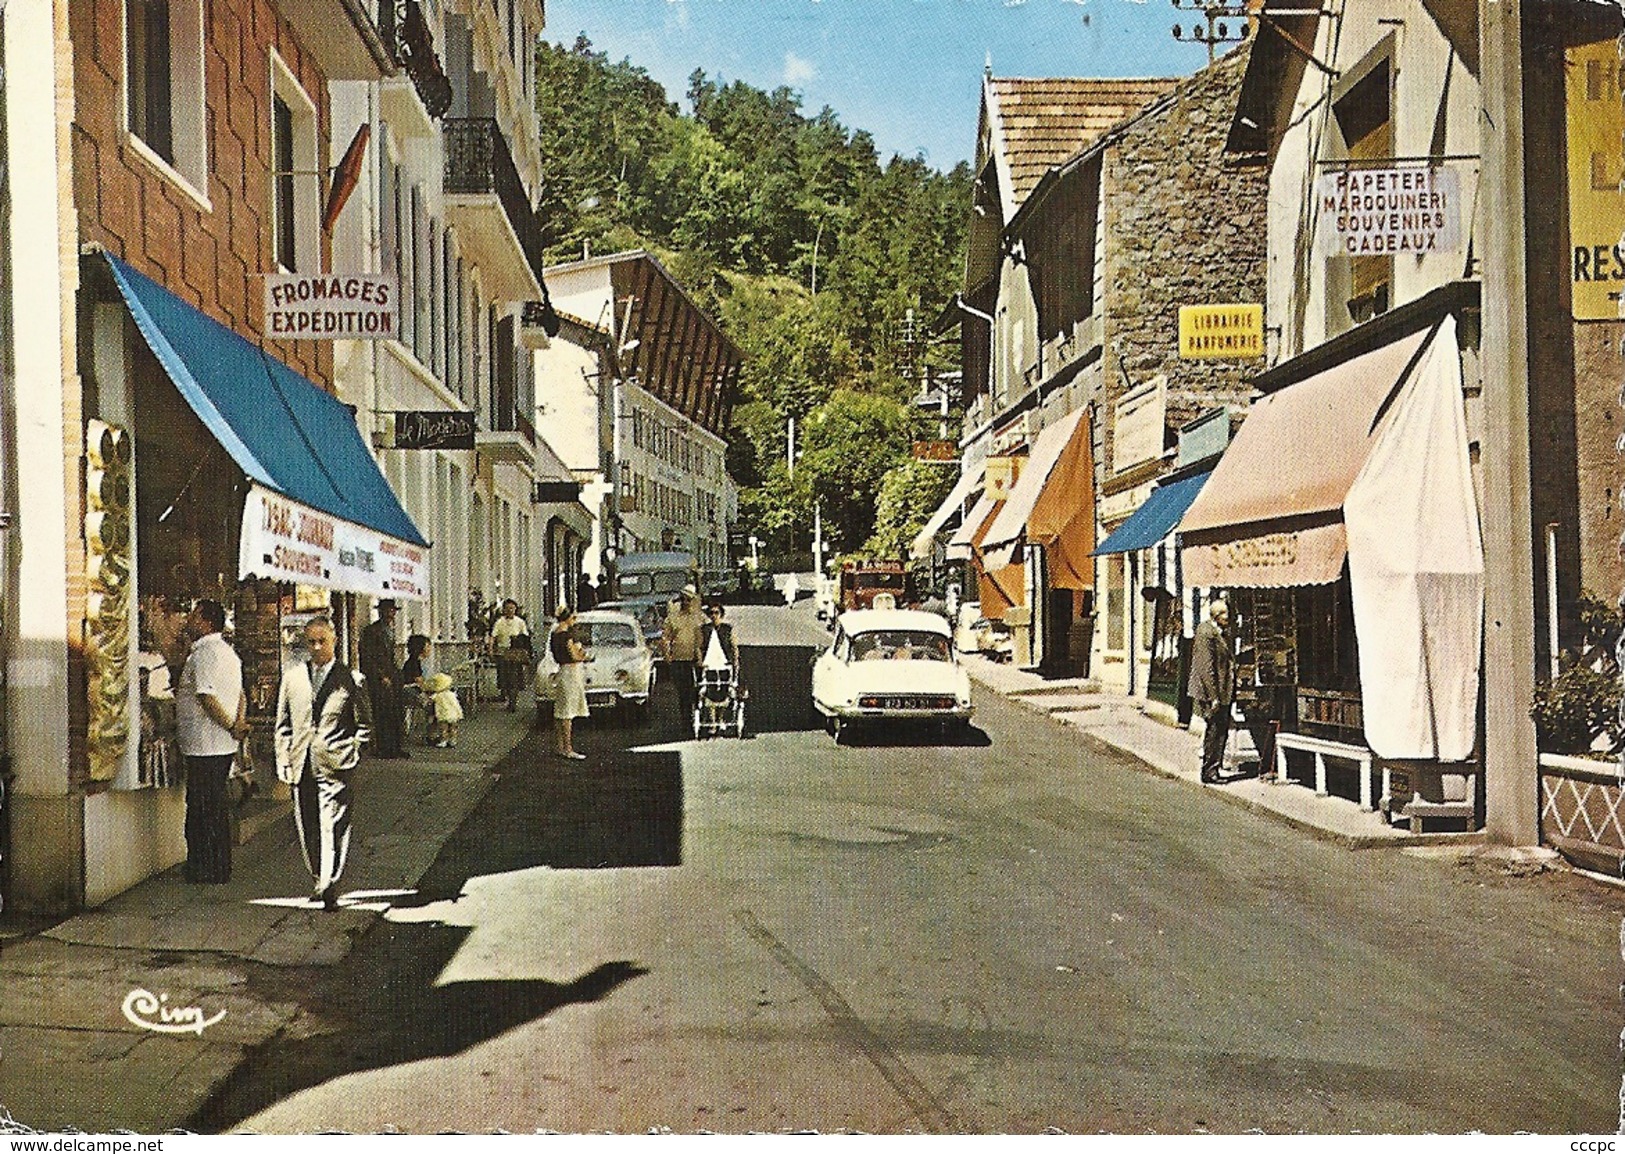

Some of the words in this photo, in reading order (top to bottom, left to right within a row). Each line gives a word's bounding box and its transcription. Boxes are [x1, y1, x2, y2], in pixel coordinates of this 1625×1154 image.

[1336, 213, 1444, 232] SOUVENIRS
[1346, 233, 1436, 251] CADEAUX
[271, 278, 389, 307] FROMAGES
[1194, 313, 1252, 330] LIBRAIRIE
[1188, 334, 1258, 350] PARFUMERIE
